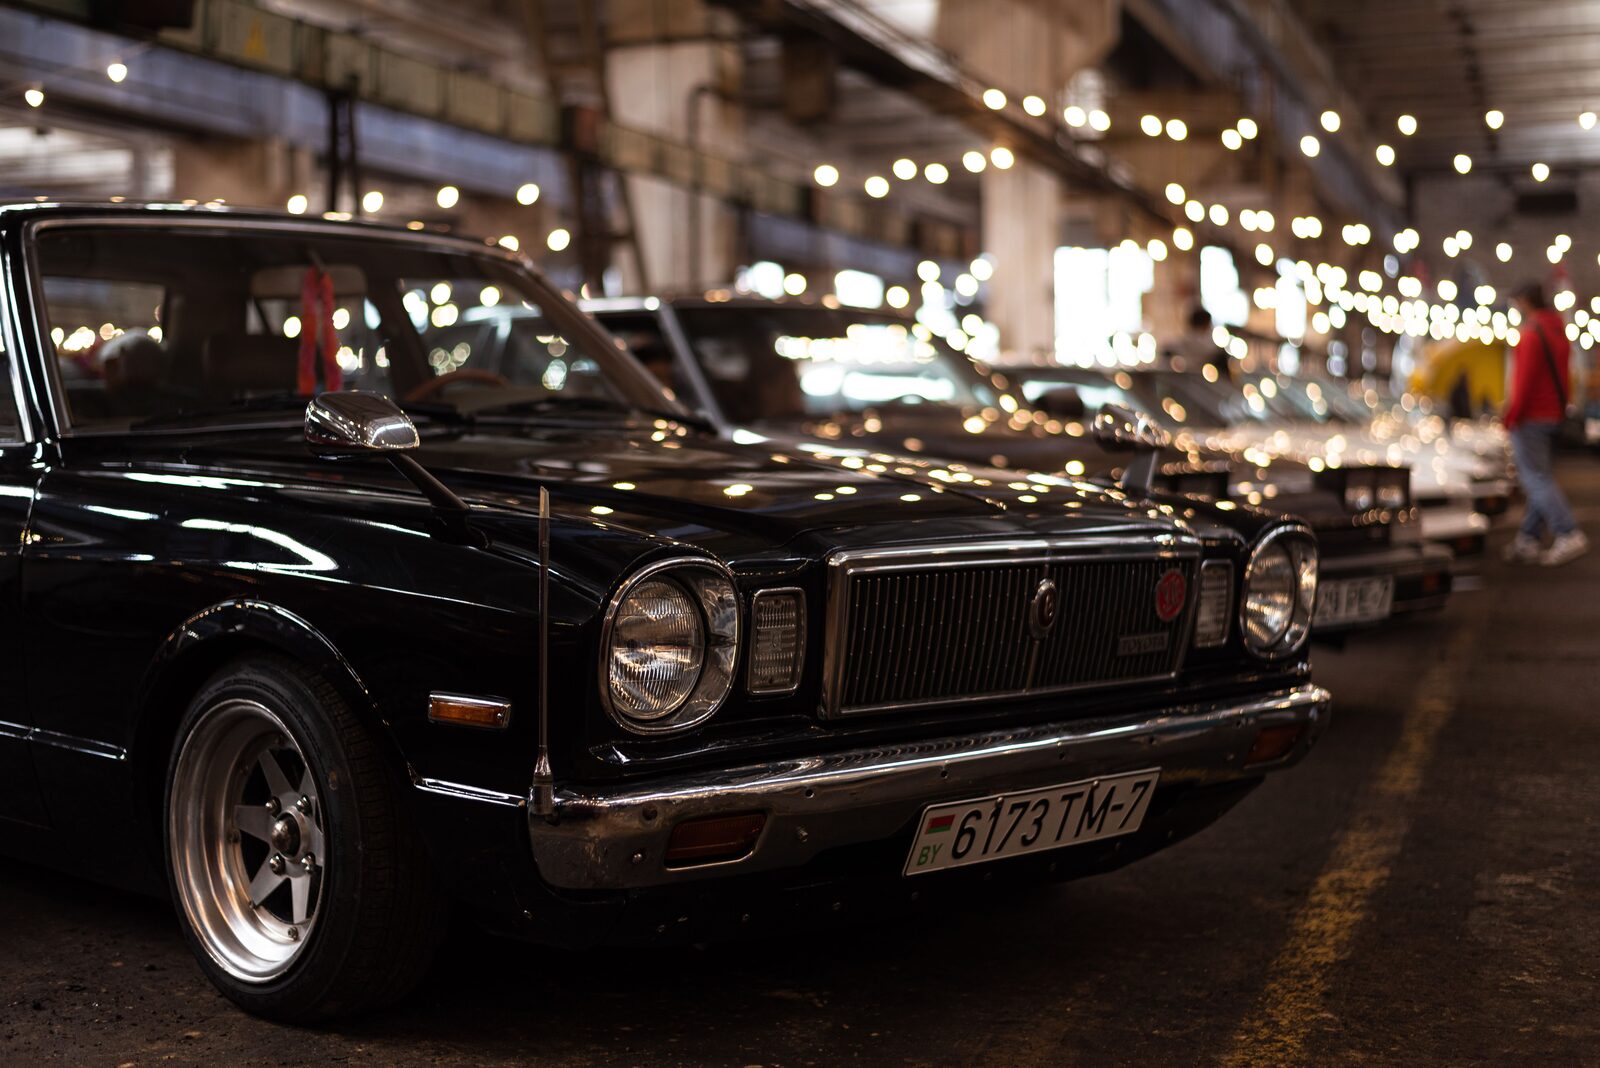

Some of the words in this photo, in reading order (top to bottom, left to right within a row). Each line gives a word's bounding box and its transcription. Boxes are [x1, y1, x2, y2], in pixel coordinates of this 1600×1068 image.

[1121, 634, 1166, 653] TOYOTA
[951, 797, 1050, 860] 6173
[1055, 779, 1153, 841] TM-7
[916, 843, 943, 866] BY
